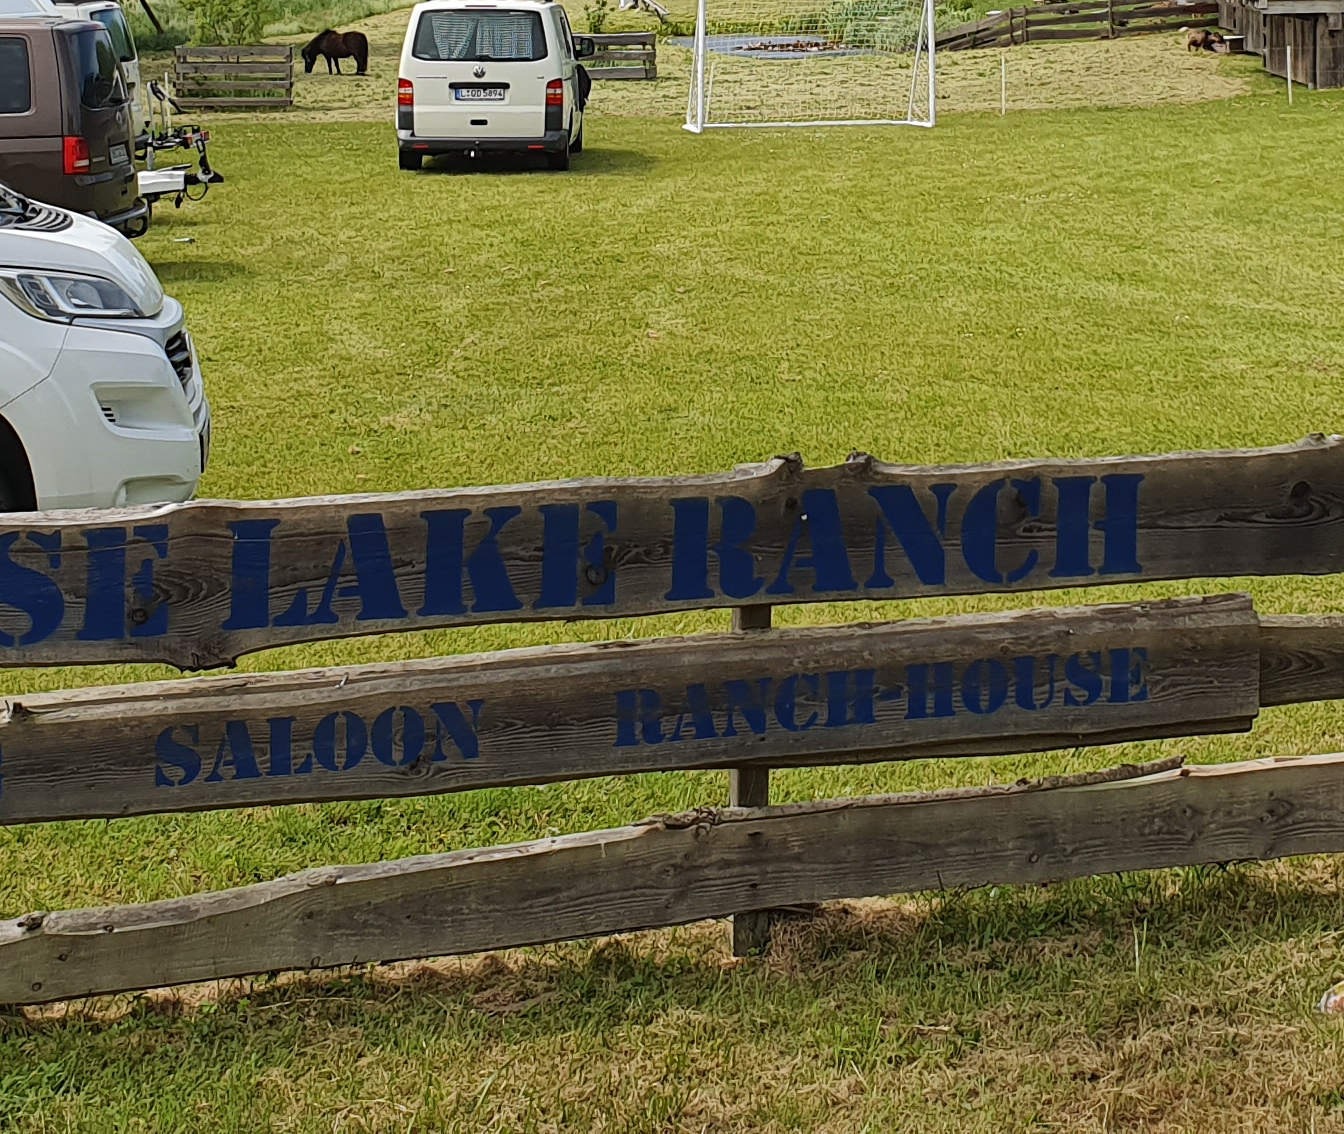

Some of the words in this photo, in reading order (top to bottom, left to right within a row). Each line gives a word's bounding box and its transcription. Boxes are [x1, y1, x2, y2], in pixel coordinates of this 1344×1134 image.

[223, 500, 617, 630] LAKE
[664, 473, 1144, 601] RANCH
[155, 699, 483, 787] SALOON
[614, 647, 1149, 748] RANCH-HOUSE
